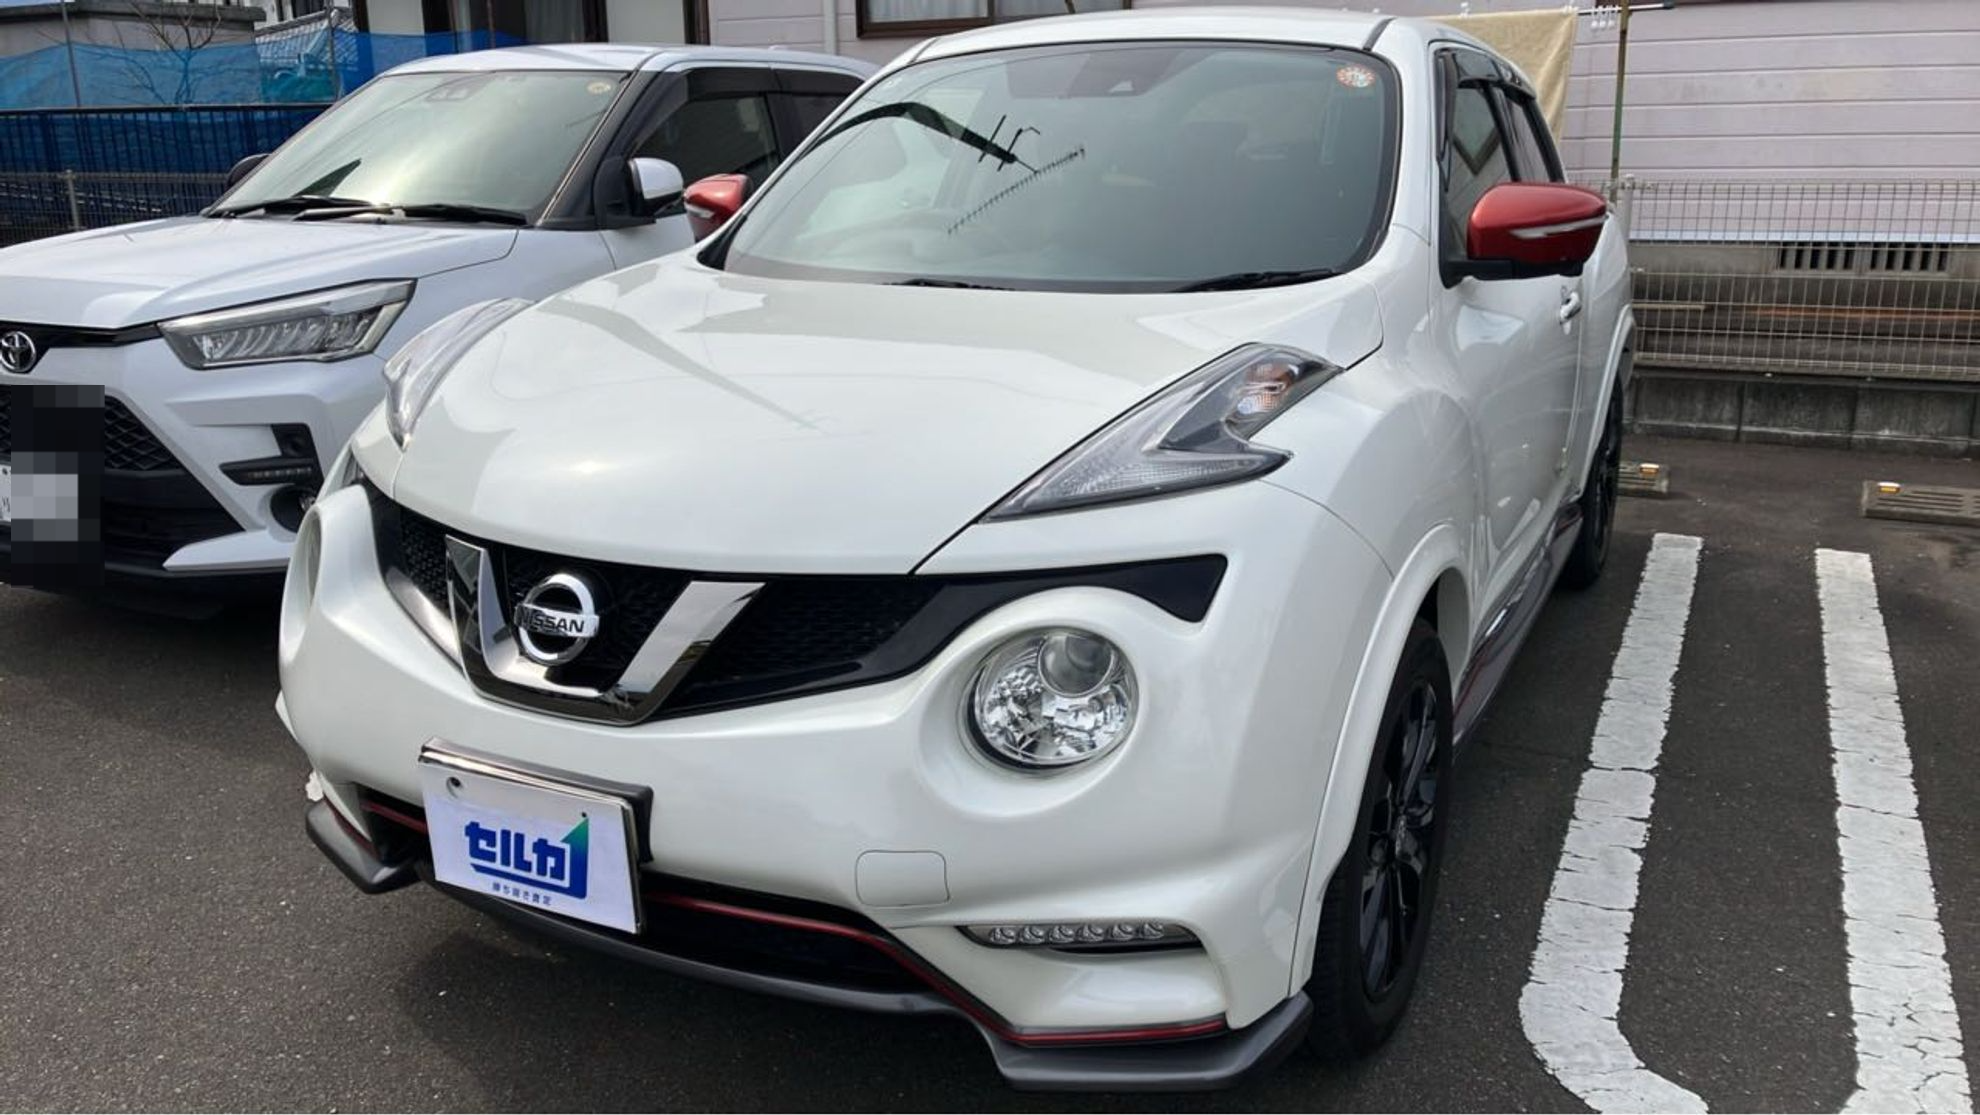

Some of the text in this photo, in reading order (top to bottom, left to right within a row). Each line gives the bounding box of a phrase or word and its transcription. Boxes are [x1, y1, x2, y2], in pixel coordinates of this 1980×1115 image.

[518, 606, 585, 633] NISSAN
[465, 821, 566, 881] セルカ
